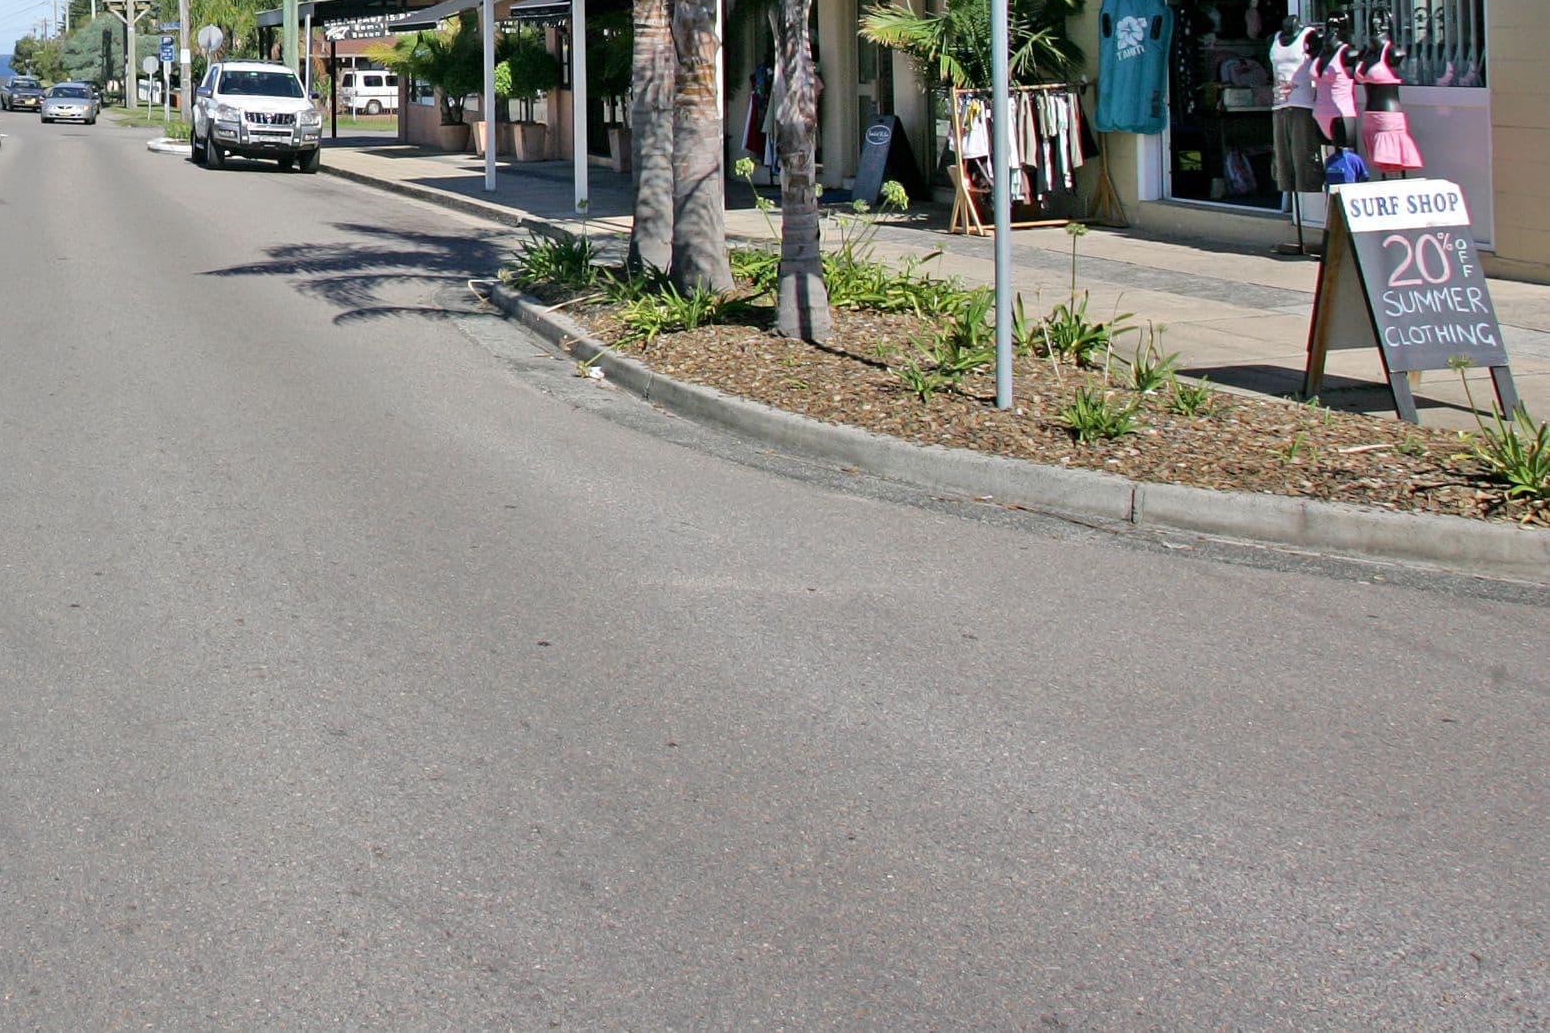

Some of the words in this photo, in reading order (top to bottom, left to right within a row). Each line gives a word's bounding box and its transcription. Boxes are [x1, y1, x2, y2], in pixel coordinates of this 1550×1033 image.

[1350, 195, 1399, 218] SURF
[1407, 192, 1459, 214] SHOP
[1382, 286, 1489, 317] SUMMER
[1384, 323, 1497, 347] CLOTHING
